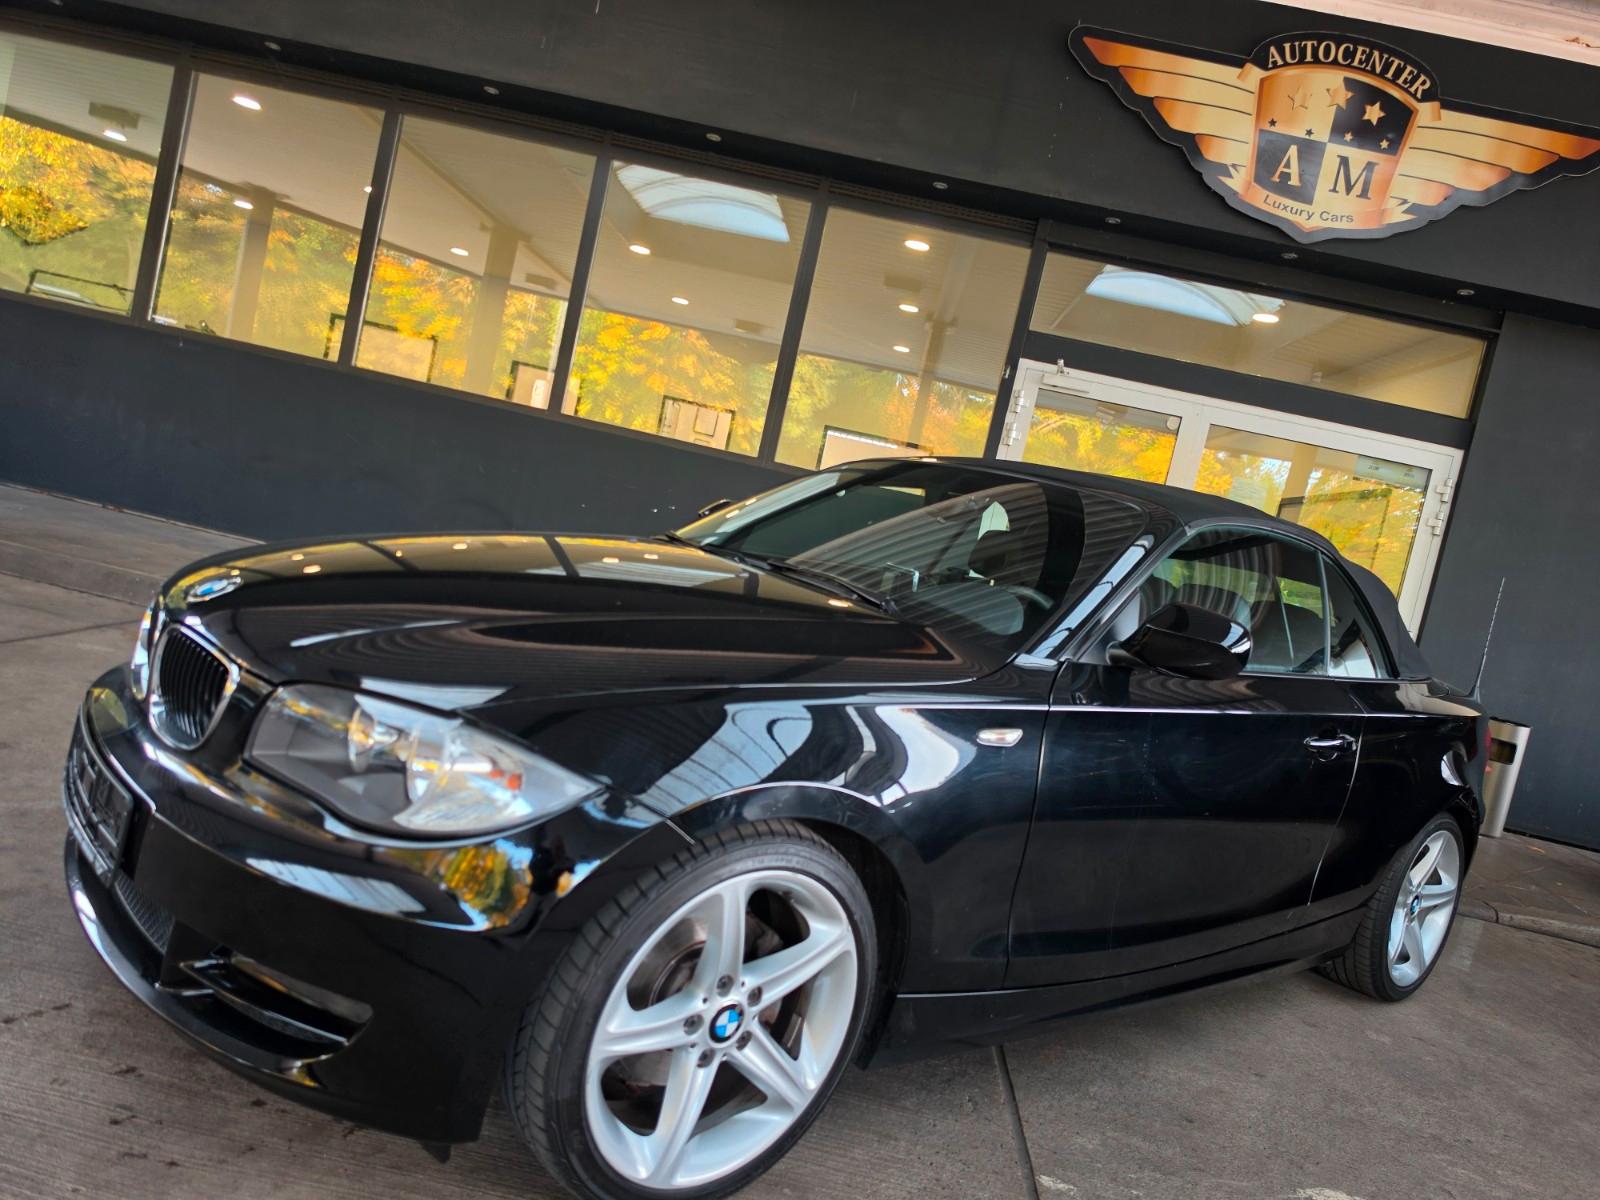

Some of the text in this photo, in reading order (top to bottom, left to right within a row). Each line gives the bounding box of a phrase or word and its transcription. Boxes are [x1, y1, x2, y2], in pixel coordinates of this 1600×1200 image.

[1267, 40, 1431, 99] AUTOCENTER
[1271, 144, 1379, 200] A M
[1263, 194, 1354, 223] Luxury Cars
